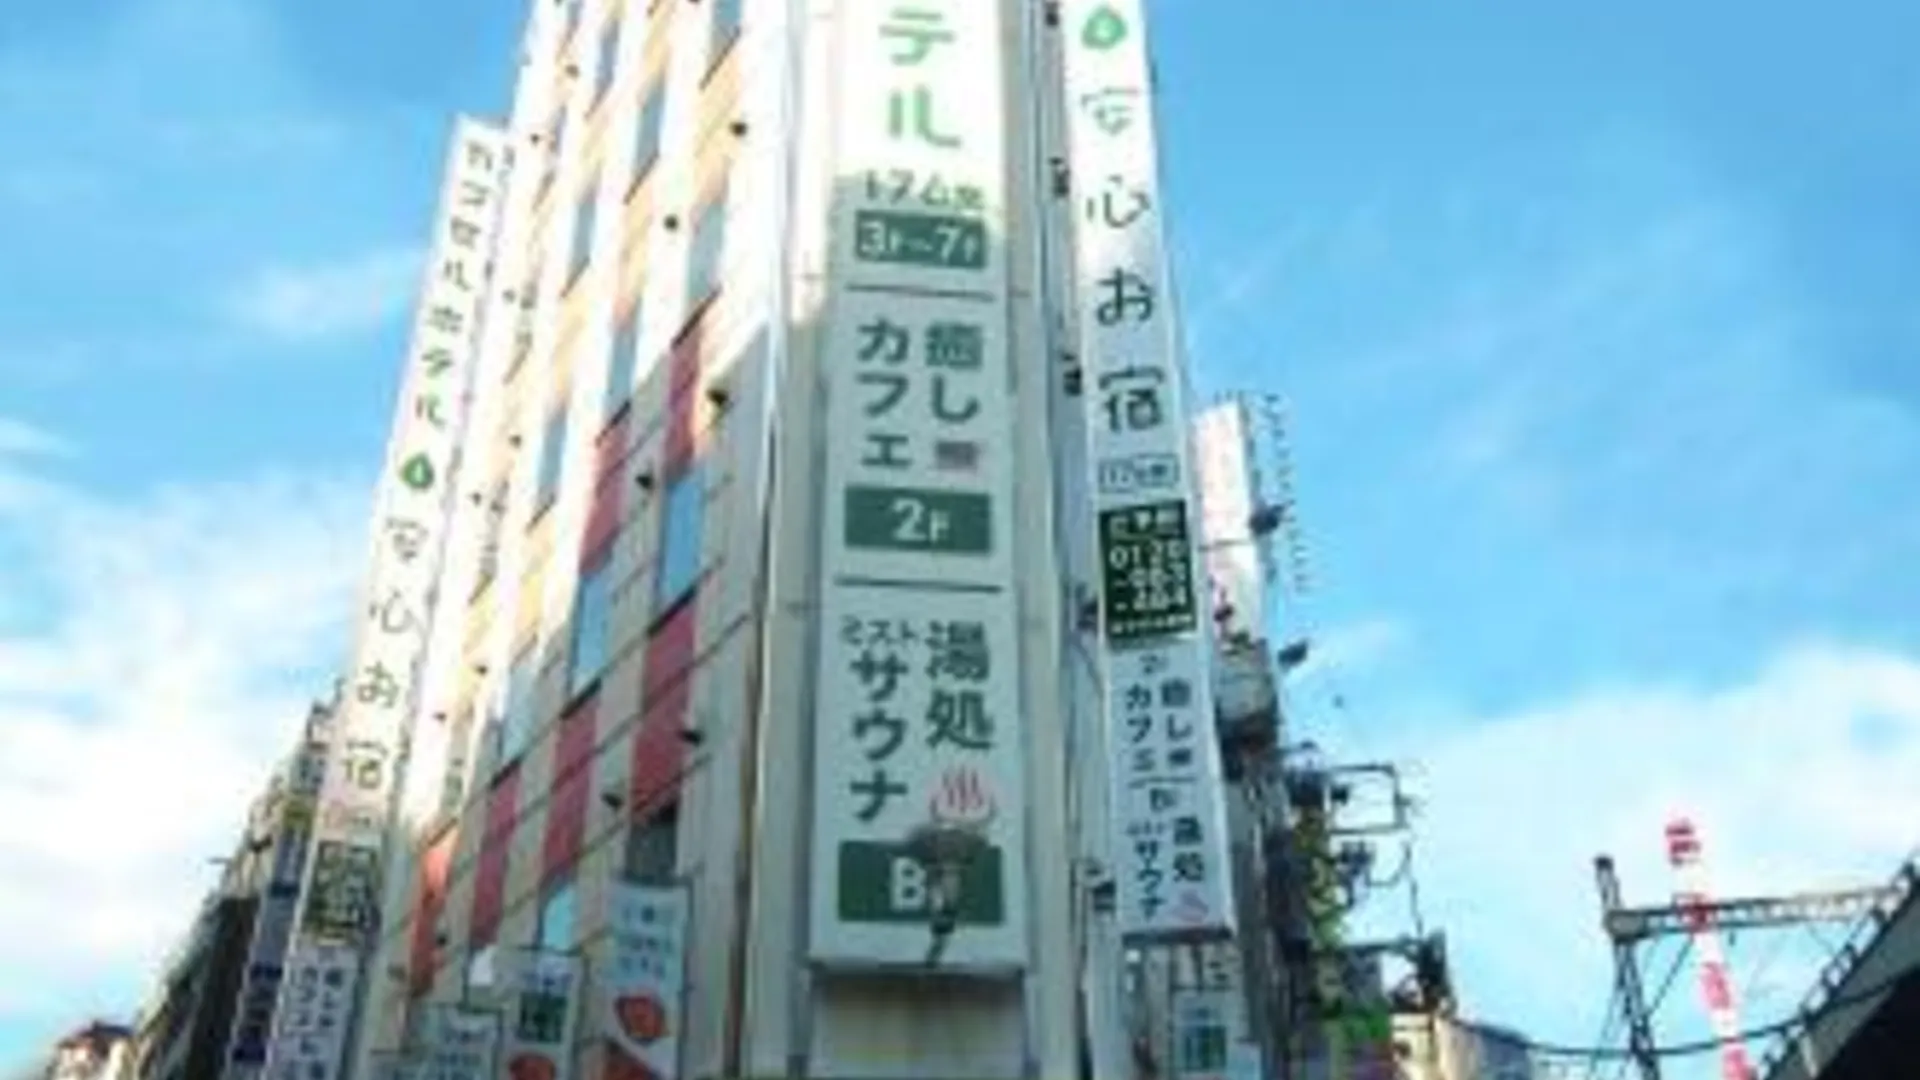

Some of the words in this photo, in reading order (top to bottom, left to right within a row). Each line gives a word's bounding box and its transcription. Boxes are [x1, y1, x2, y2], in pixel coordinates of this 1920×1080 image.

[856, 315, 913, 470] カフェ
[892, 498, 950, 544] 2F
[847, 648, 910, 824] サウナ
